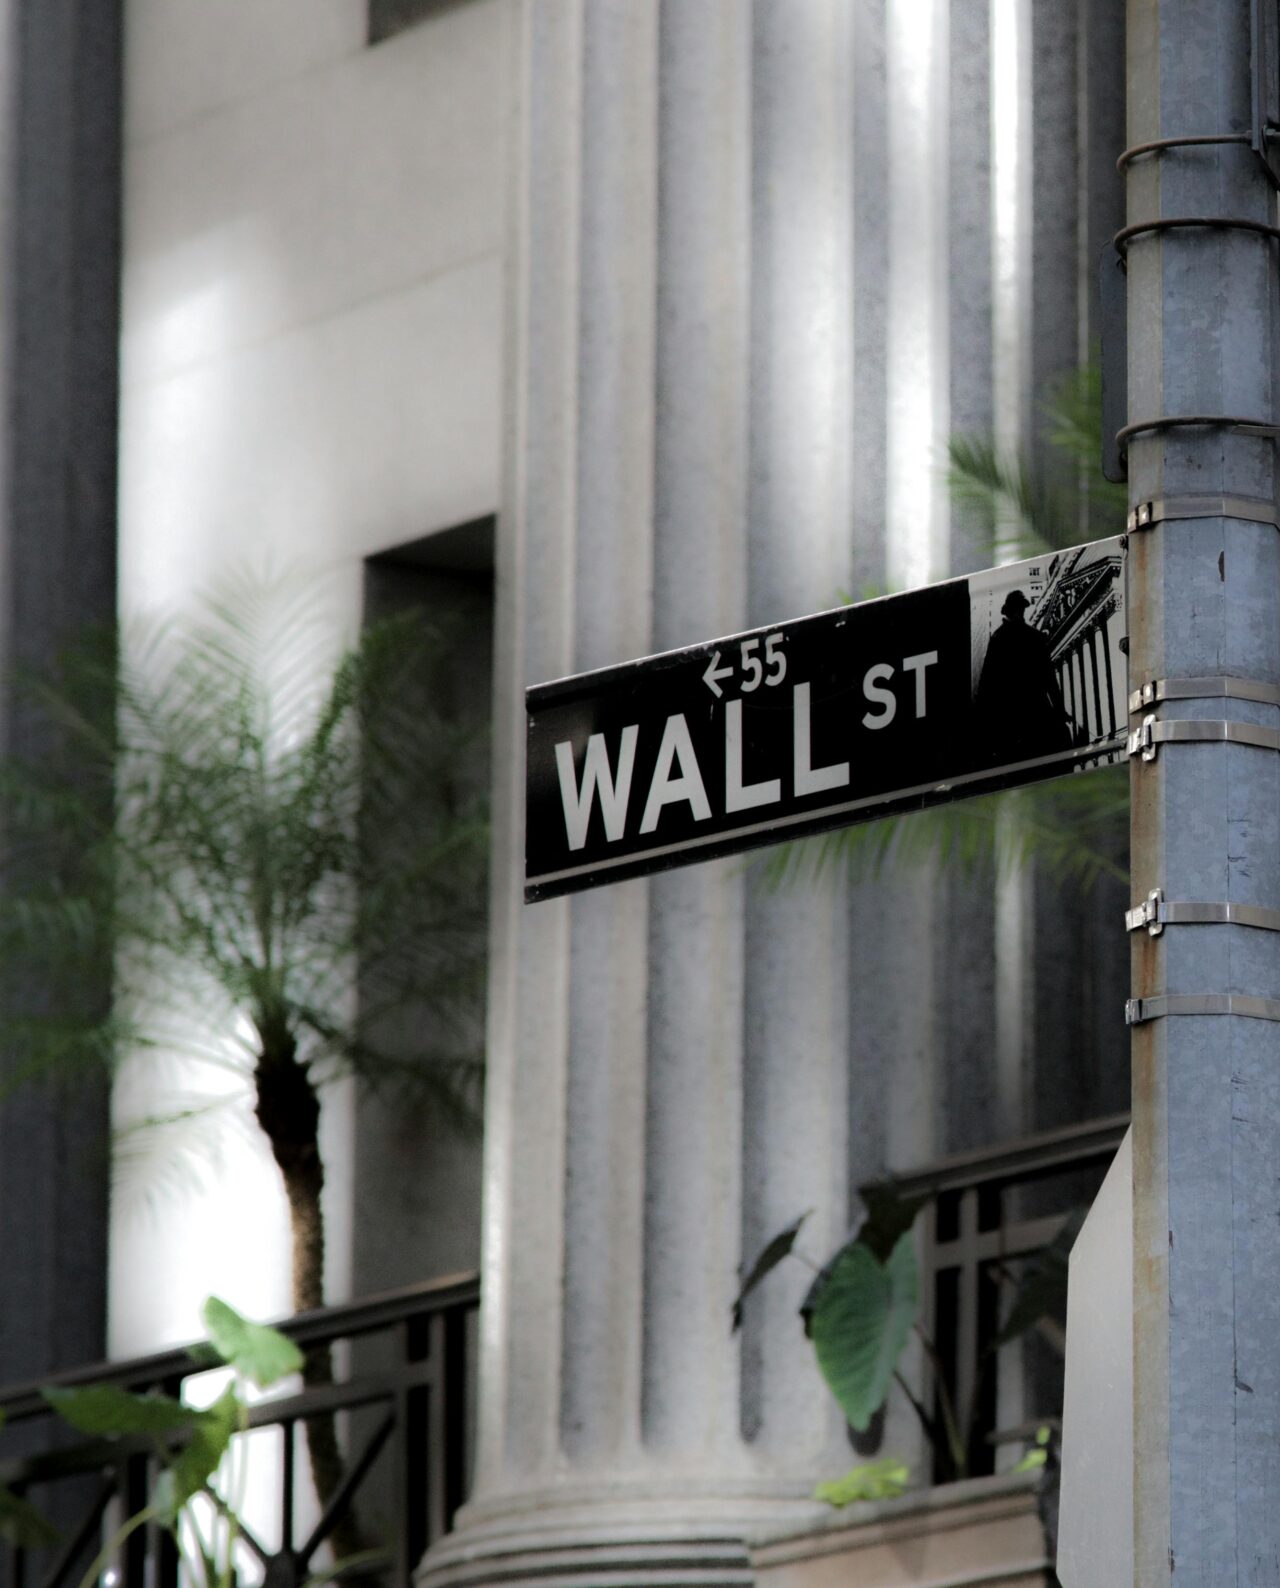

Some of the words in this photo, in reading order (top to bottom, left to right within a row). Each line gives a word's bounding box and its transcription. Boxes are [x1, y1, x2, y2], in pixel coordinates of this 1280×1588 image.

[740, 633, 787, 693] 55
[554, 682, 850, 851] WALL
[862, 650, 938, 730] ST
